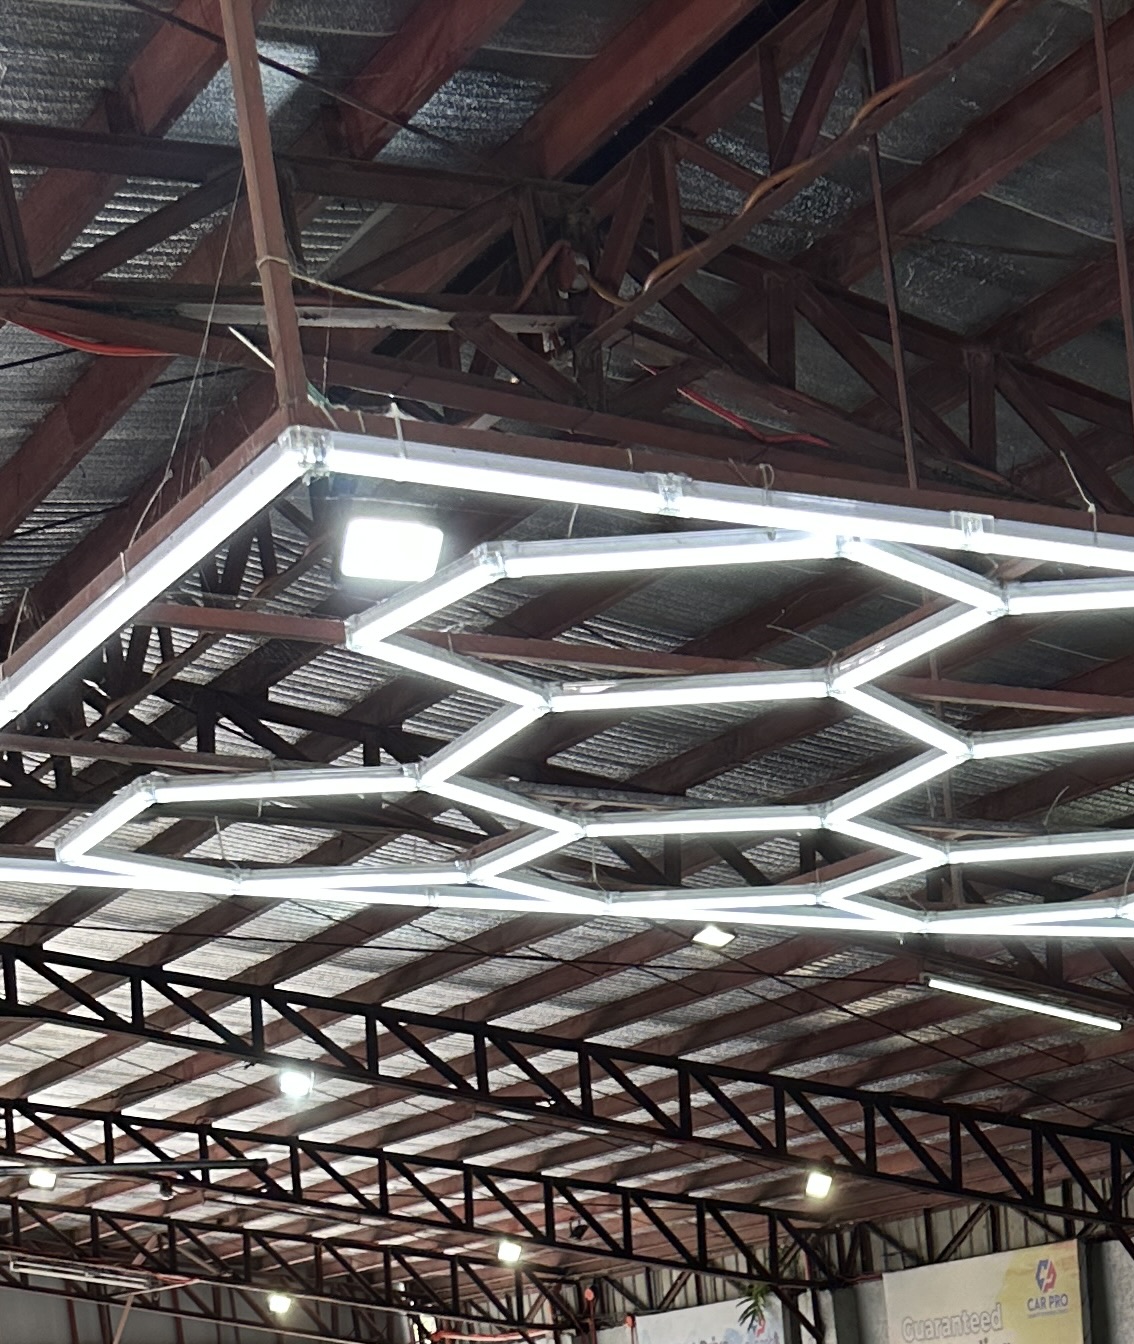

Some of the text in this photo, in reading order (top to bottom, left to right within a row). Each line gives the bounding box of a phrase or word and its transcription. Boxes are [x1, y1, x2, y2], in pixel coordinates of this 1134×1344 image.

[1027, 1293, 1068, 1311] CAR PRO
[902, 1302, 1004, 1343] Guaranteed
